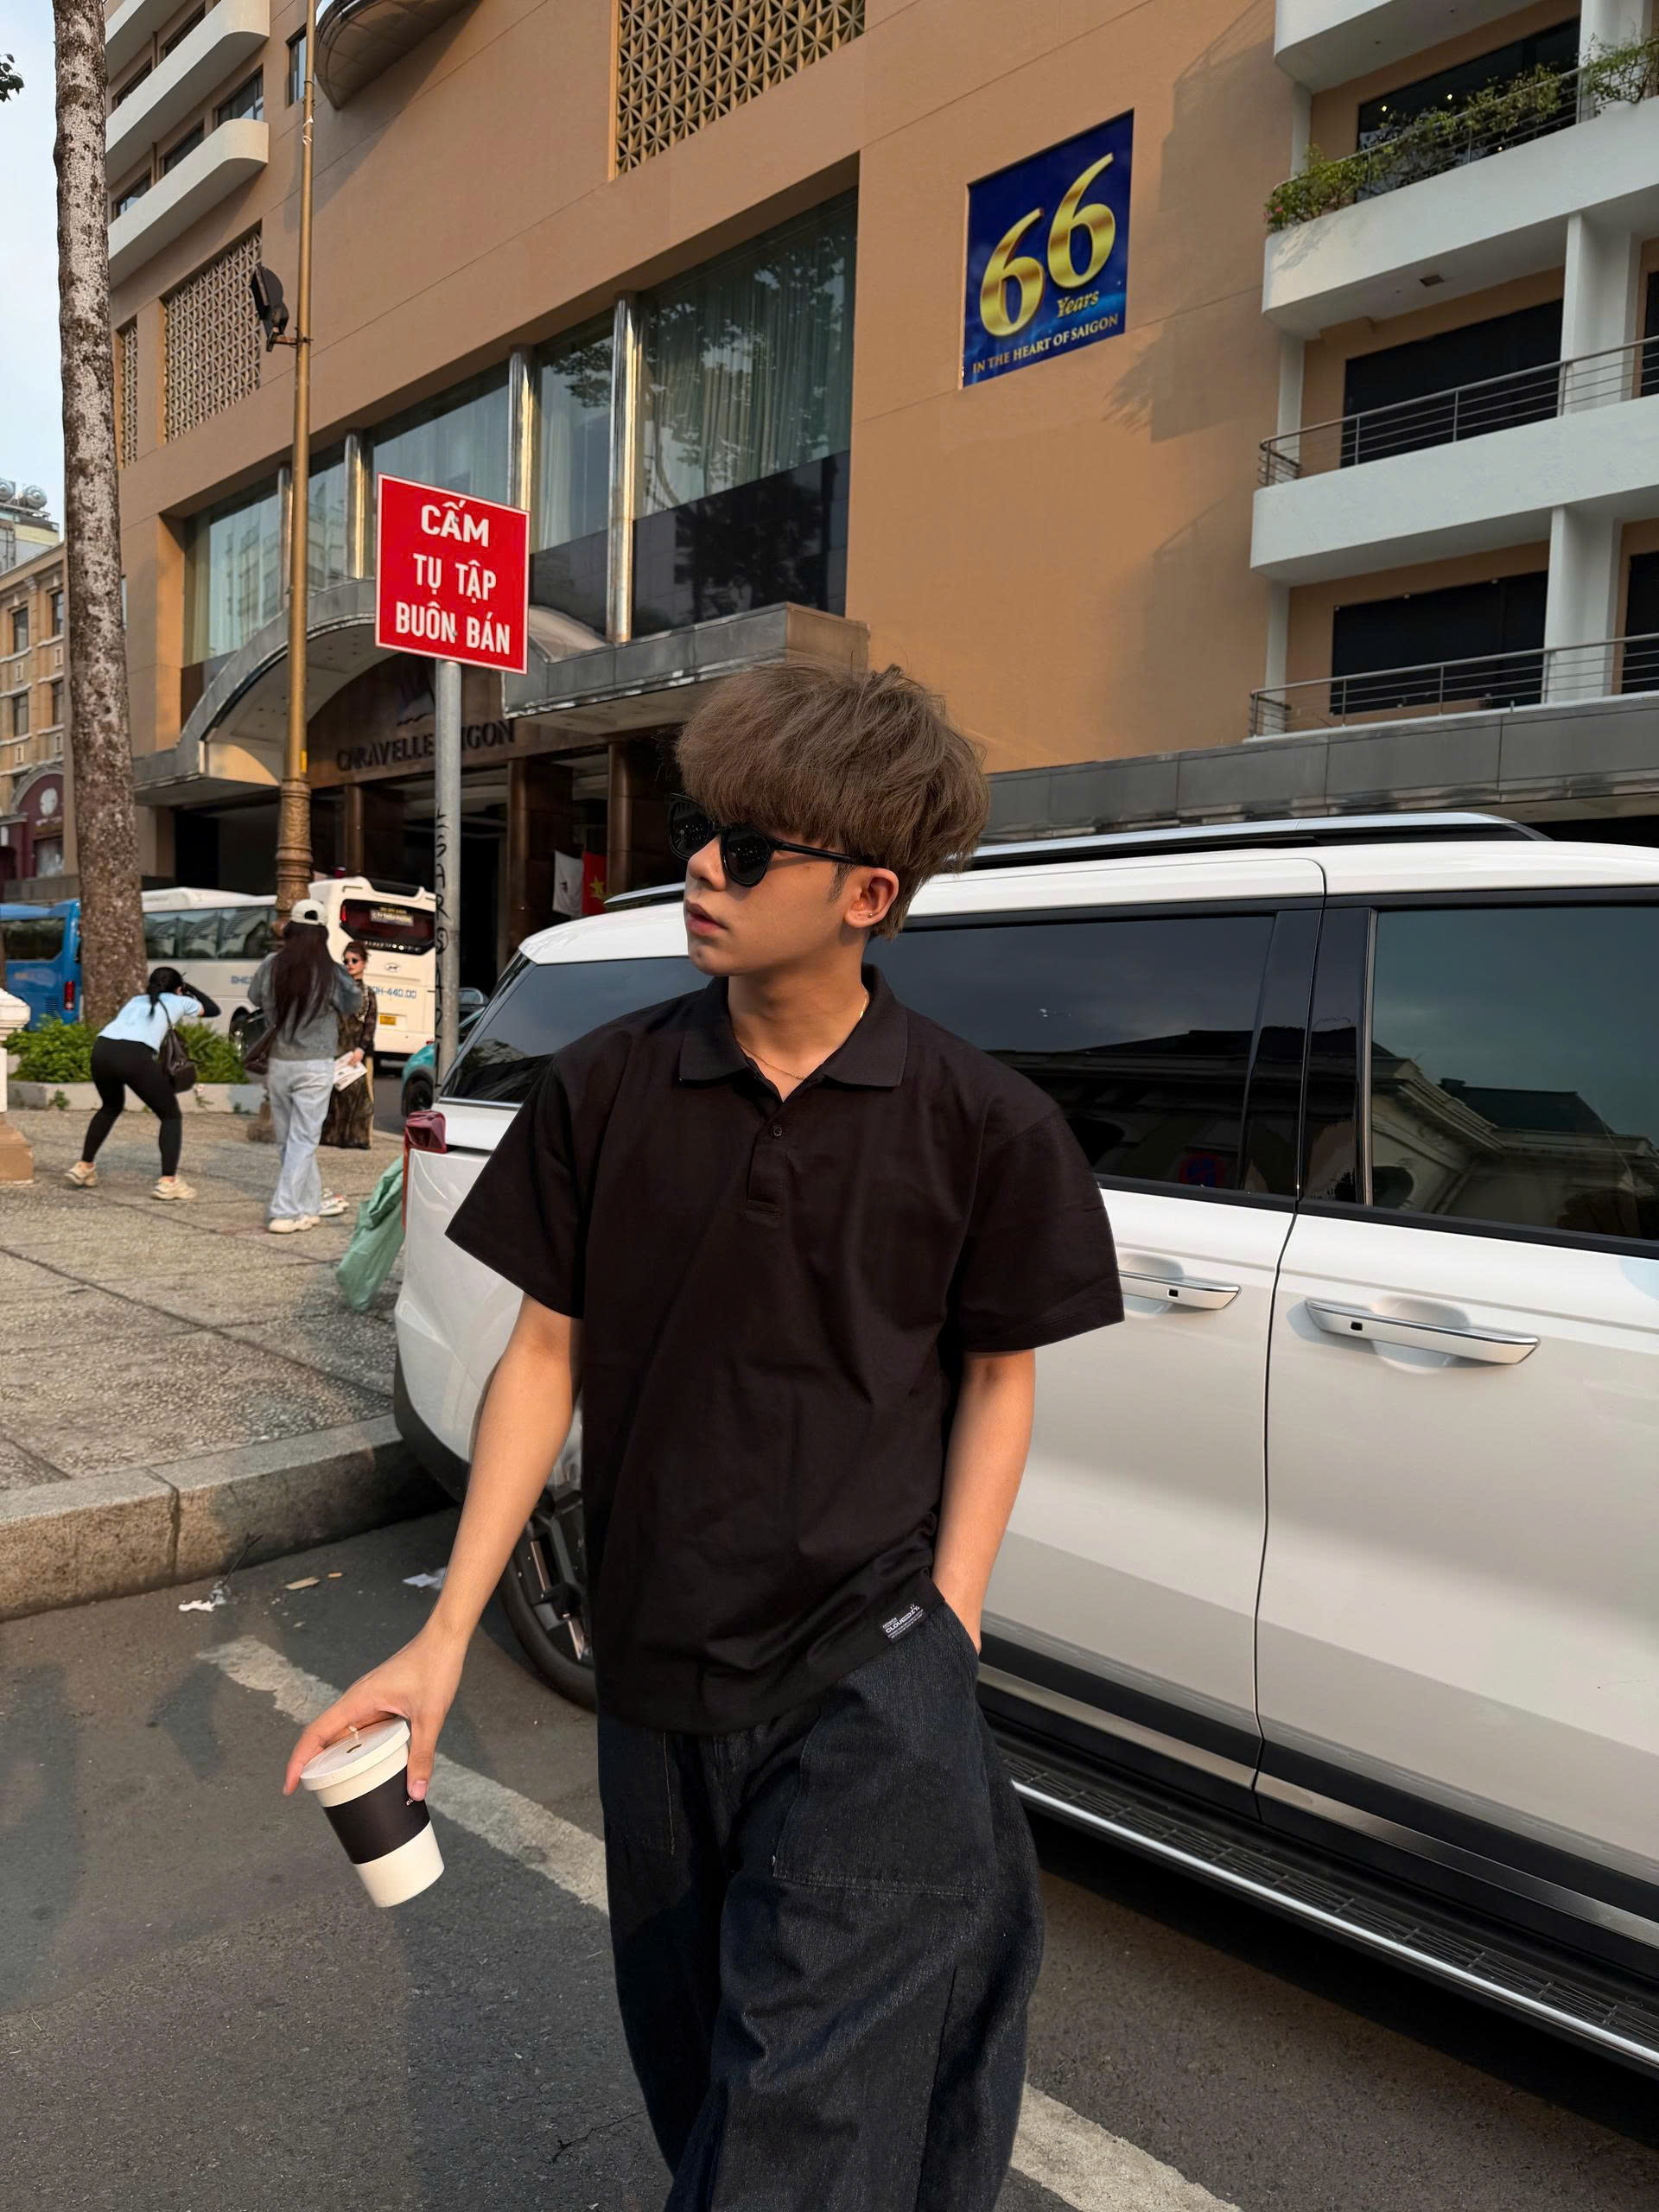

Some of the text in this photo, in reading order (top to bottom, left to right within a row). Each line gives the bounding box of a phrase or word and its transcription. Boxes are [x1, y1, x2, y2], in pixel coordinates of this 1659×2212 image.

[980, 152, 1116, 336] 66
[1057, 290, 1099, 318] Years
[973, 314, 1119, 373] IN THE HEART OF SAIGON
[421, 499, 490, 547] CẤM
[413, 553, 497, 603] TỤ TẬP
[396, 601, 511, 655] BUÔN BÁN
